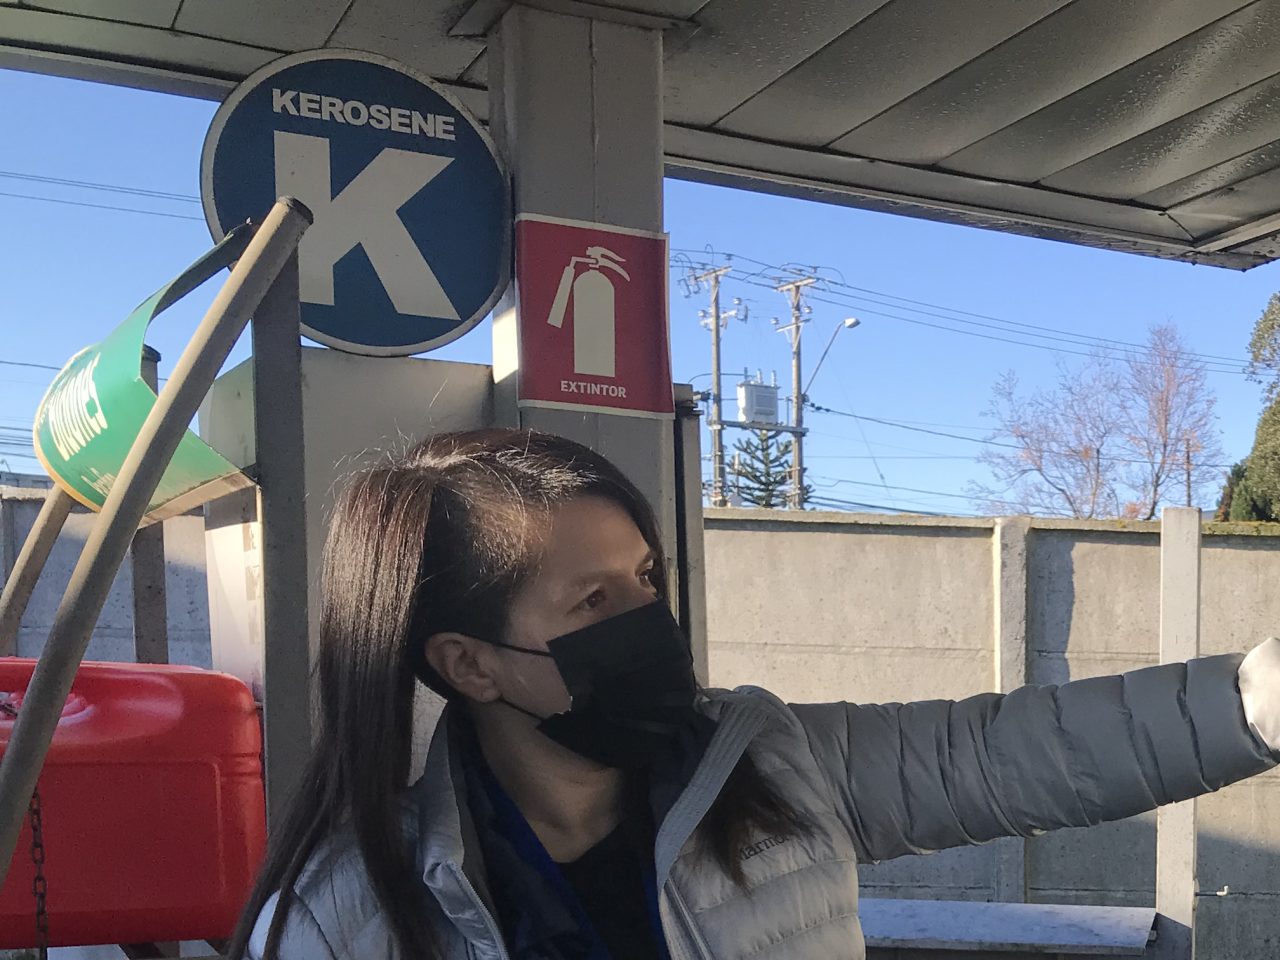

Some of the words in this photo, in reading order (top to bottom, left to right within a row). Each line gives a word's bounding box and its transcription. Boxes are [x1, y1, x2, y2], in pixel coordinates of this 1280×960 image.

[272, 88, 456, 141] KEROSENE
[273, 130, 462, 321] K
[560, 380, 627, 398] EXTINTOR
[740, 834, 789, 860] armo
